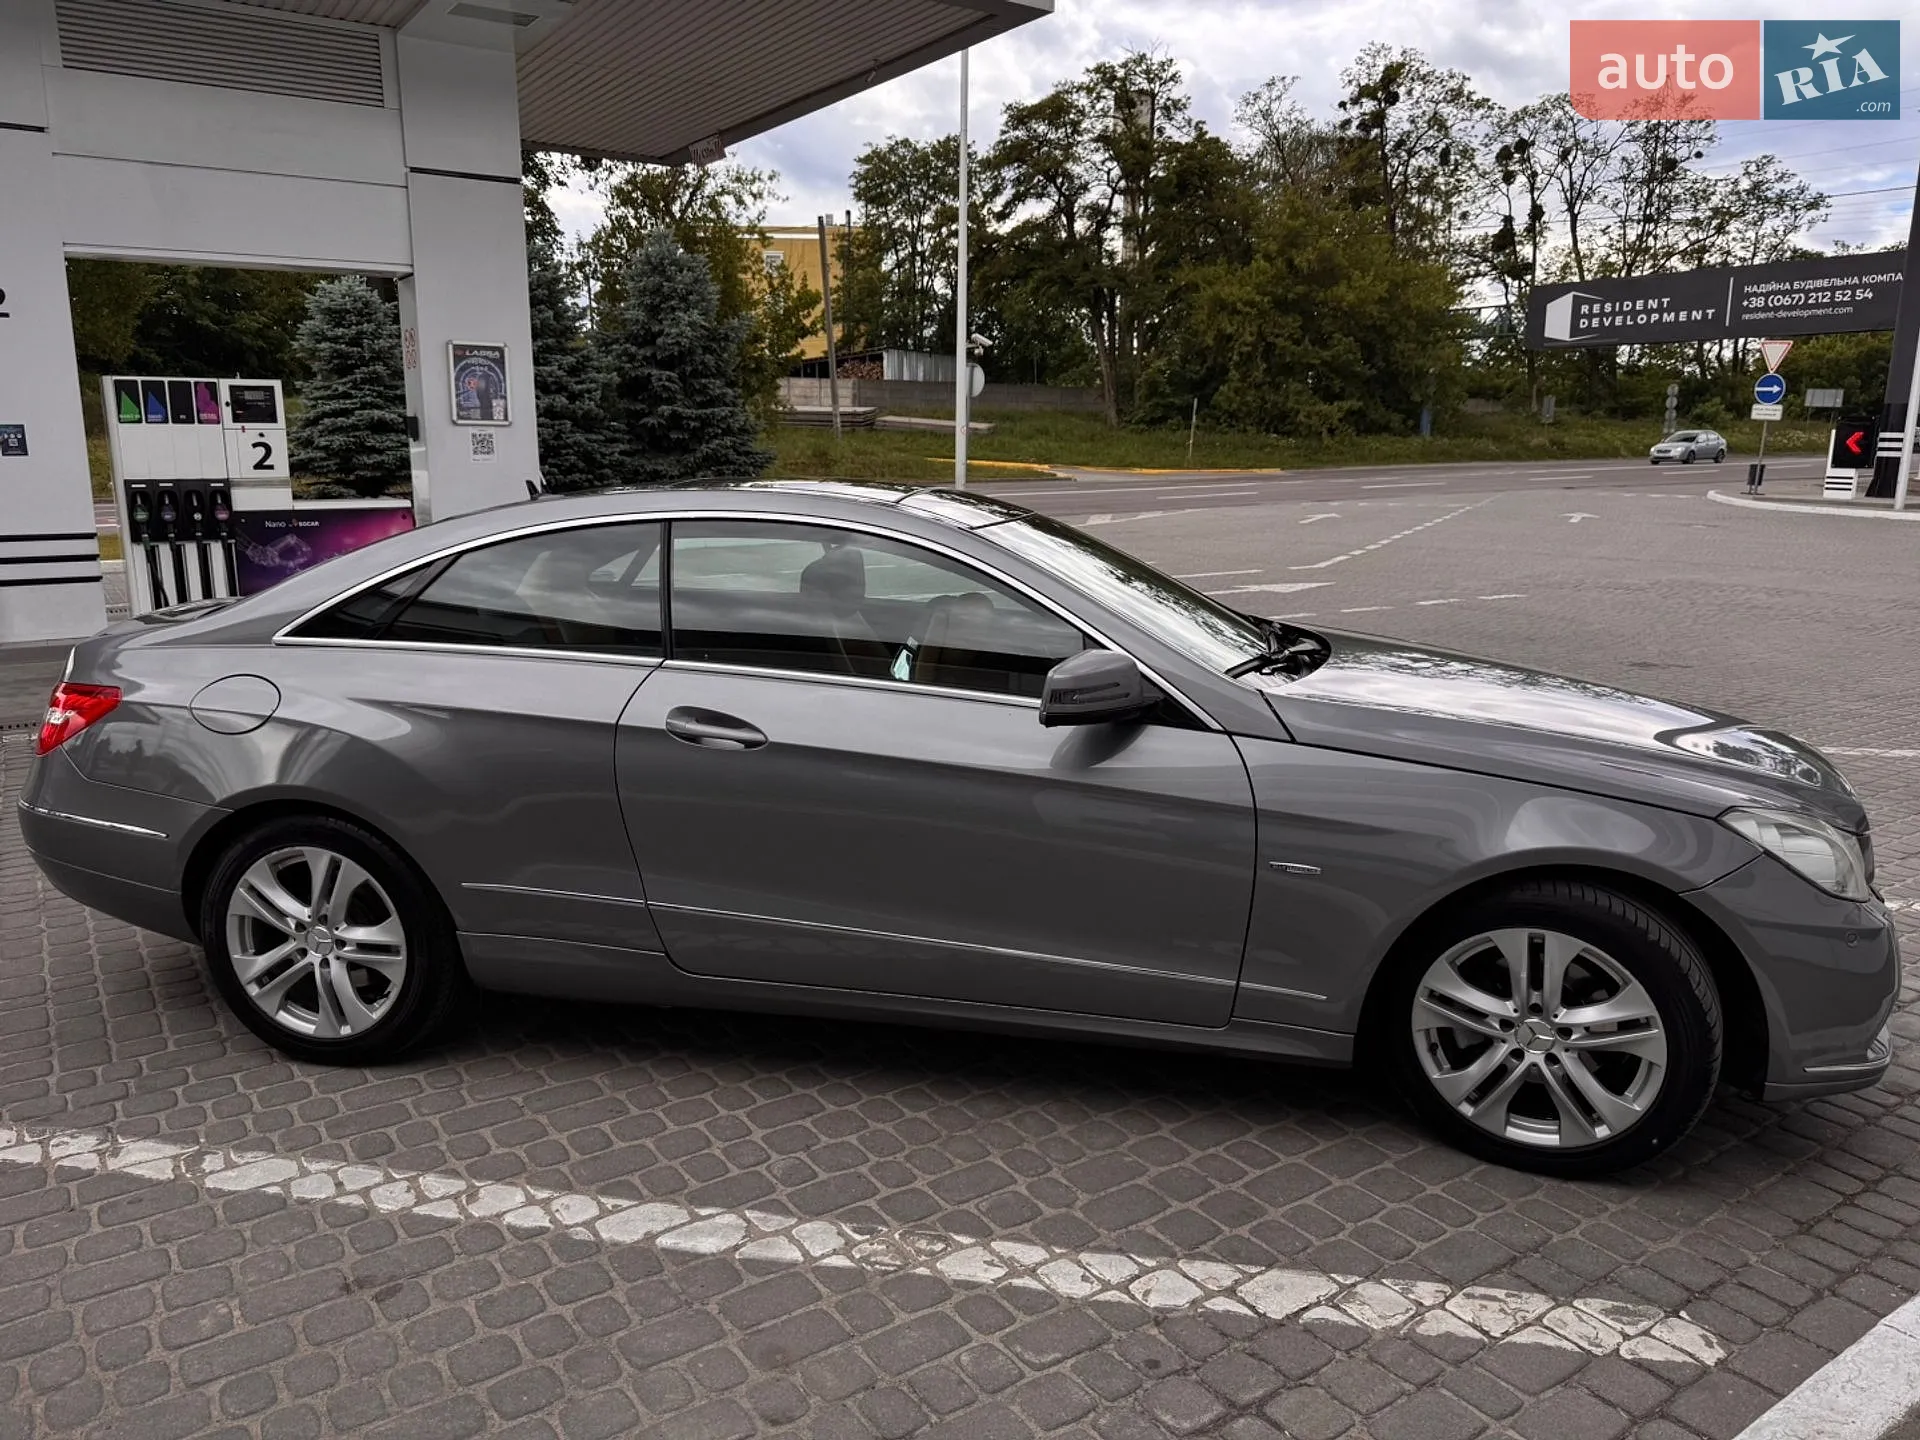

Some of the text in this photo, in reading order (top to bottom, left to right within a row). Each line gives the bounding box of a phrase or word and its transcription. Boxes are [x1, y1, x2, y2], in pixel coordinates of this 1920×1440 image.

[1744, 281, 1791, 294] НАДІЙНА
[1580, 297, 1671, 315] RESIDENT
[1742, 288, 1874, 309] +38 (067) 212 52 54
[1579, 308, 1716, 329] DEVELOPMENT
[1741, 305, 1854, 321] resident-development.com
[251, 441, 275, 470] 2
[265, 520, 287, 528] Nano
